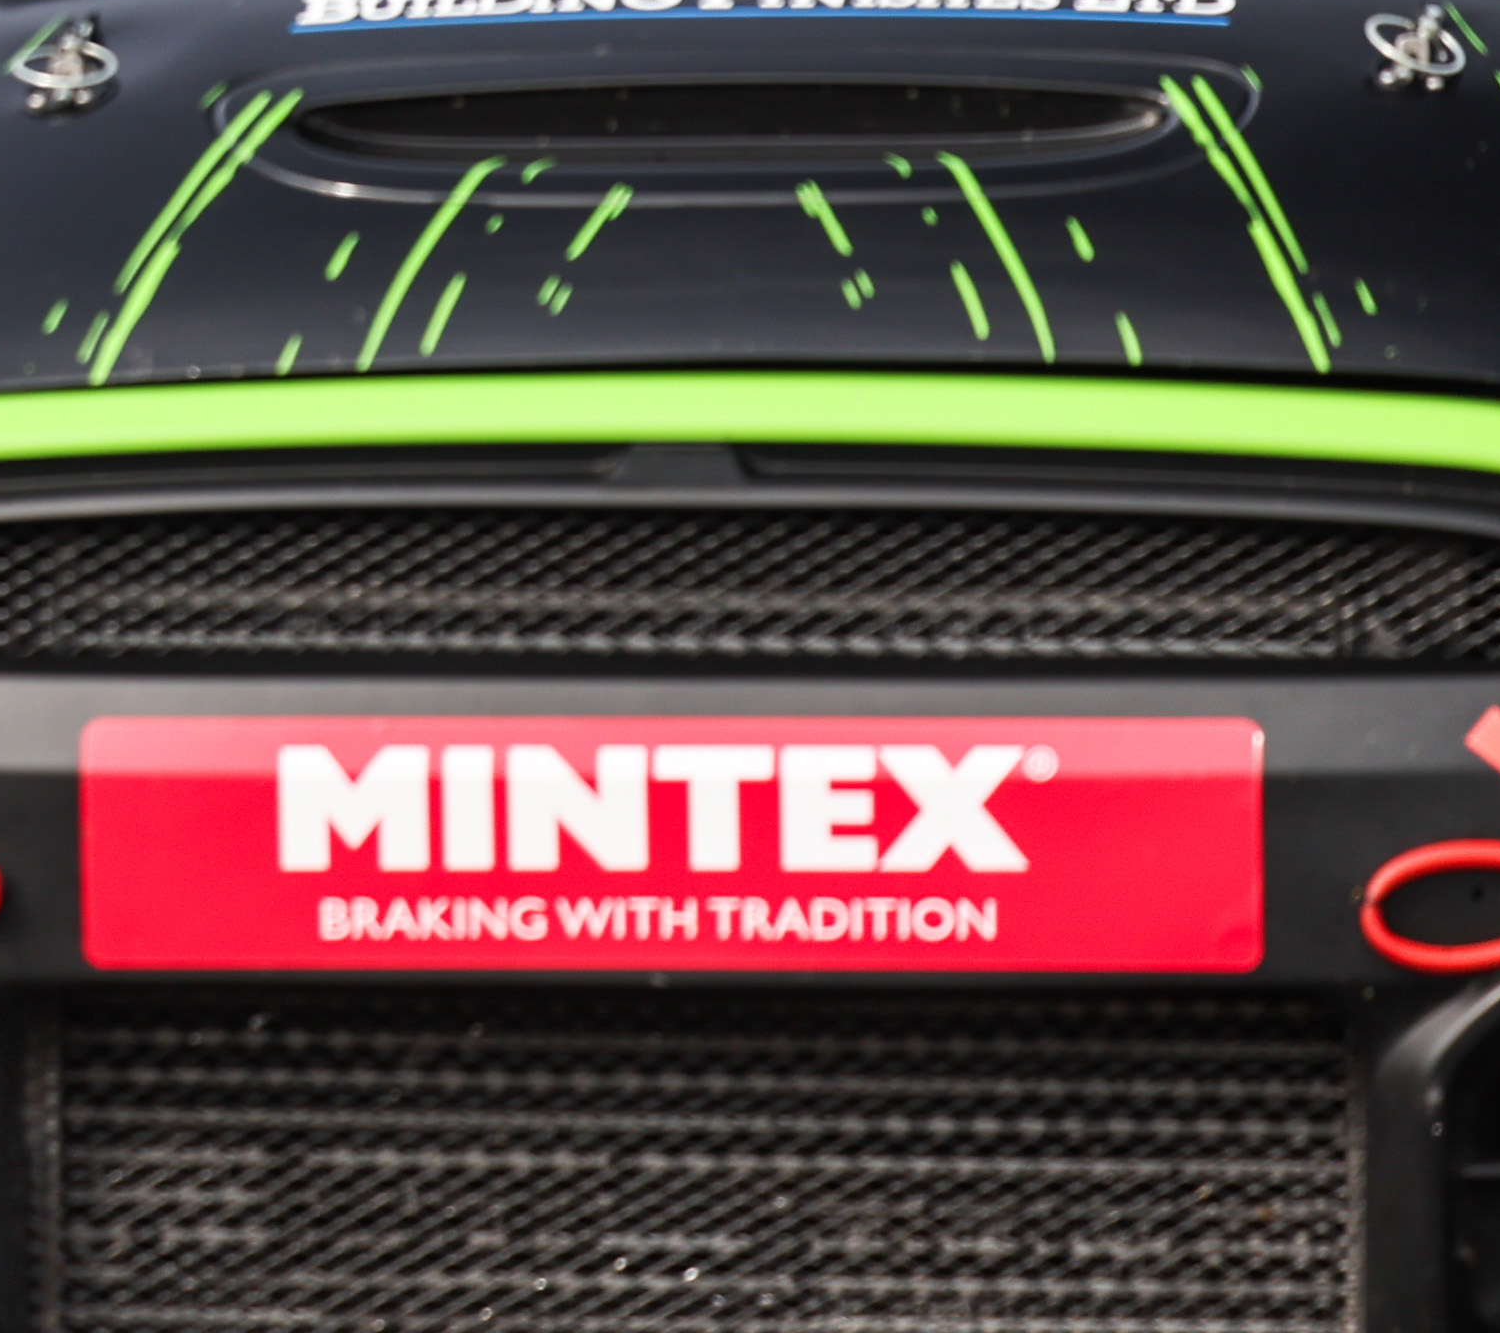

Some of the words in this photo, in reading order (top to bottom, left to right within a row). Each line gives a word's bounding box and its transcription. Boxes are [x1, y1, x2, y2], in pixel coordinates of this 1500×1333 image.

[277, 745, 1029, 872] MINTEX
[318, 897, 547, 941] BRAKING
[556, 897, 698, 941] WITH
[708, 897, 998, 941] TRADITION
